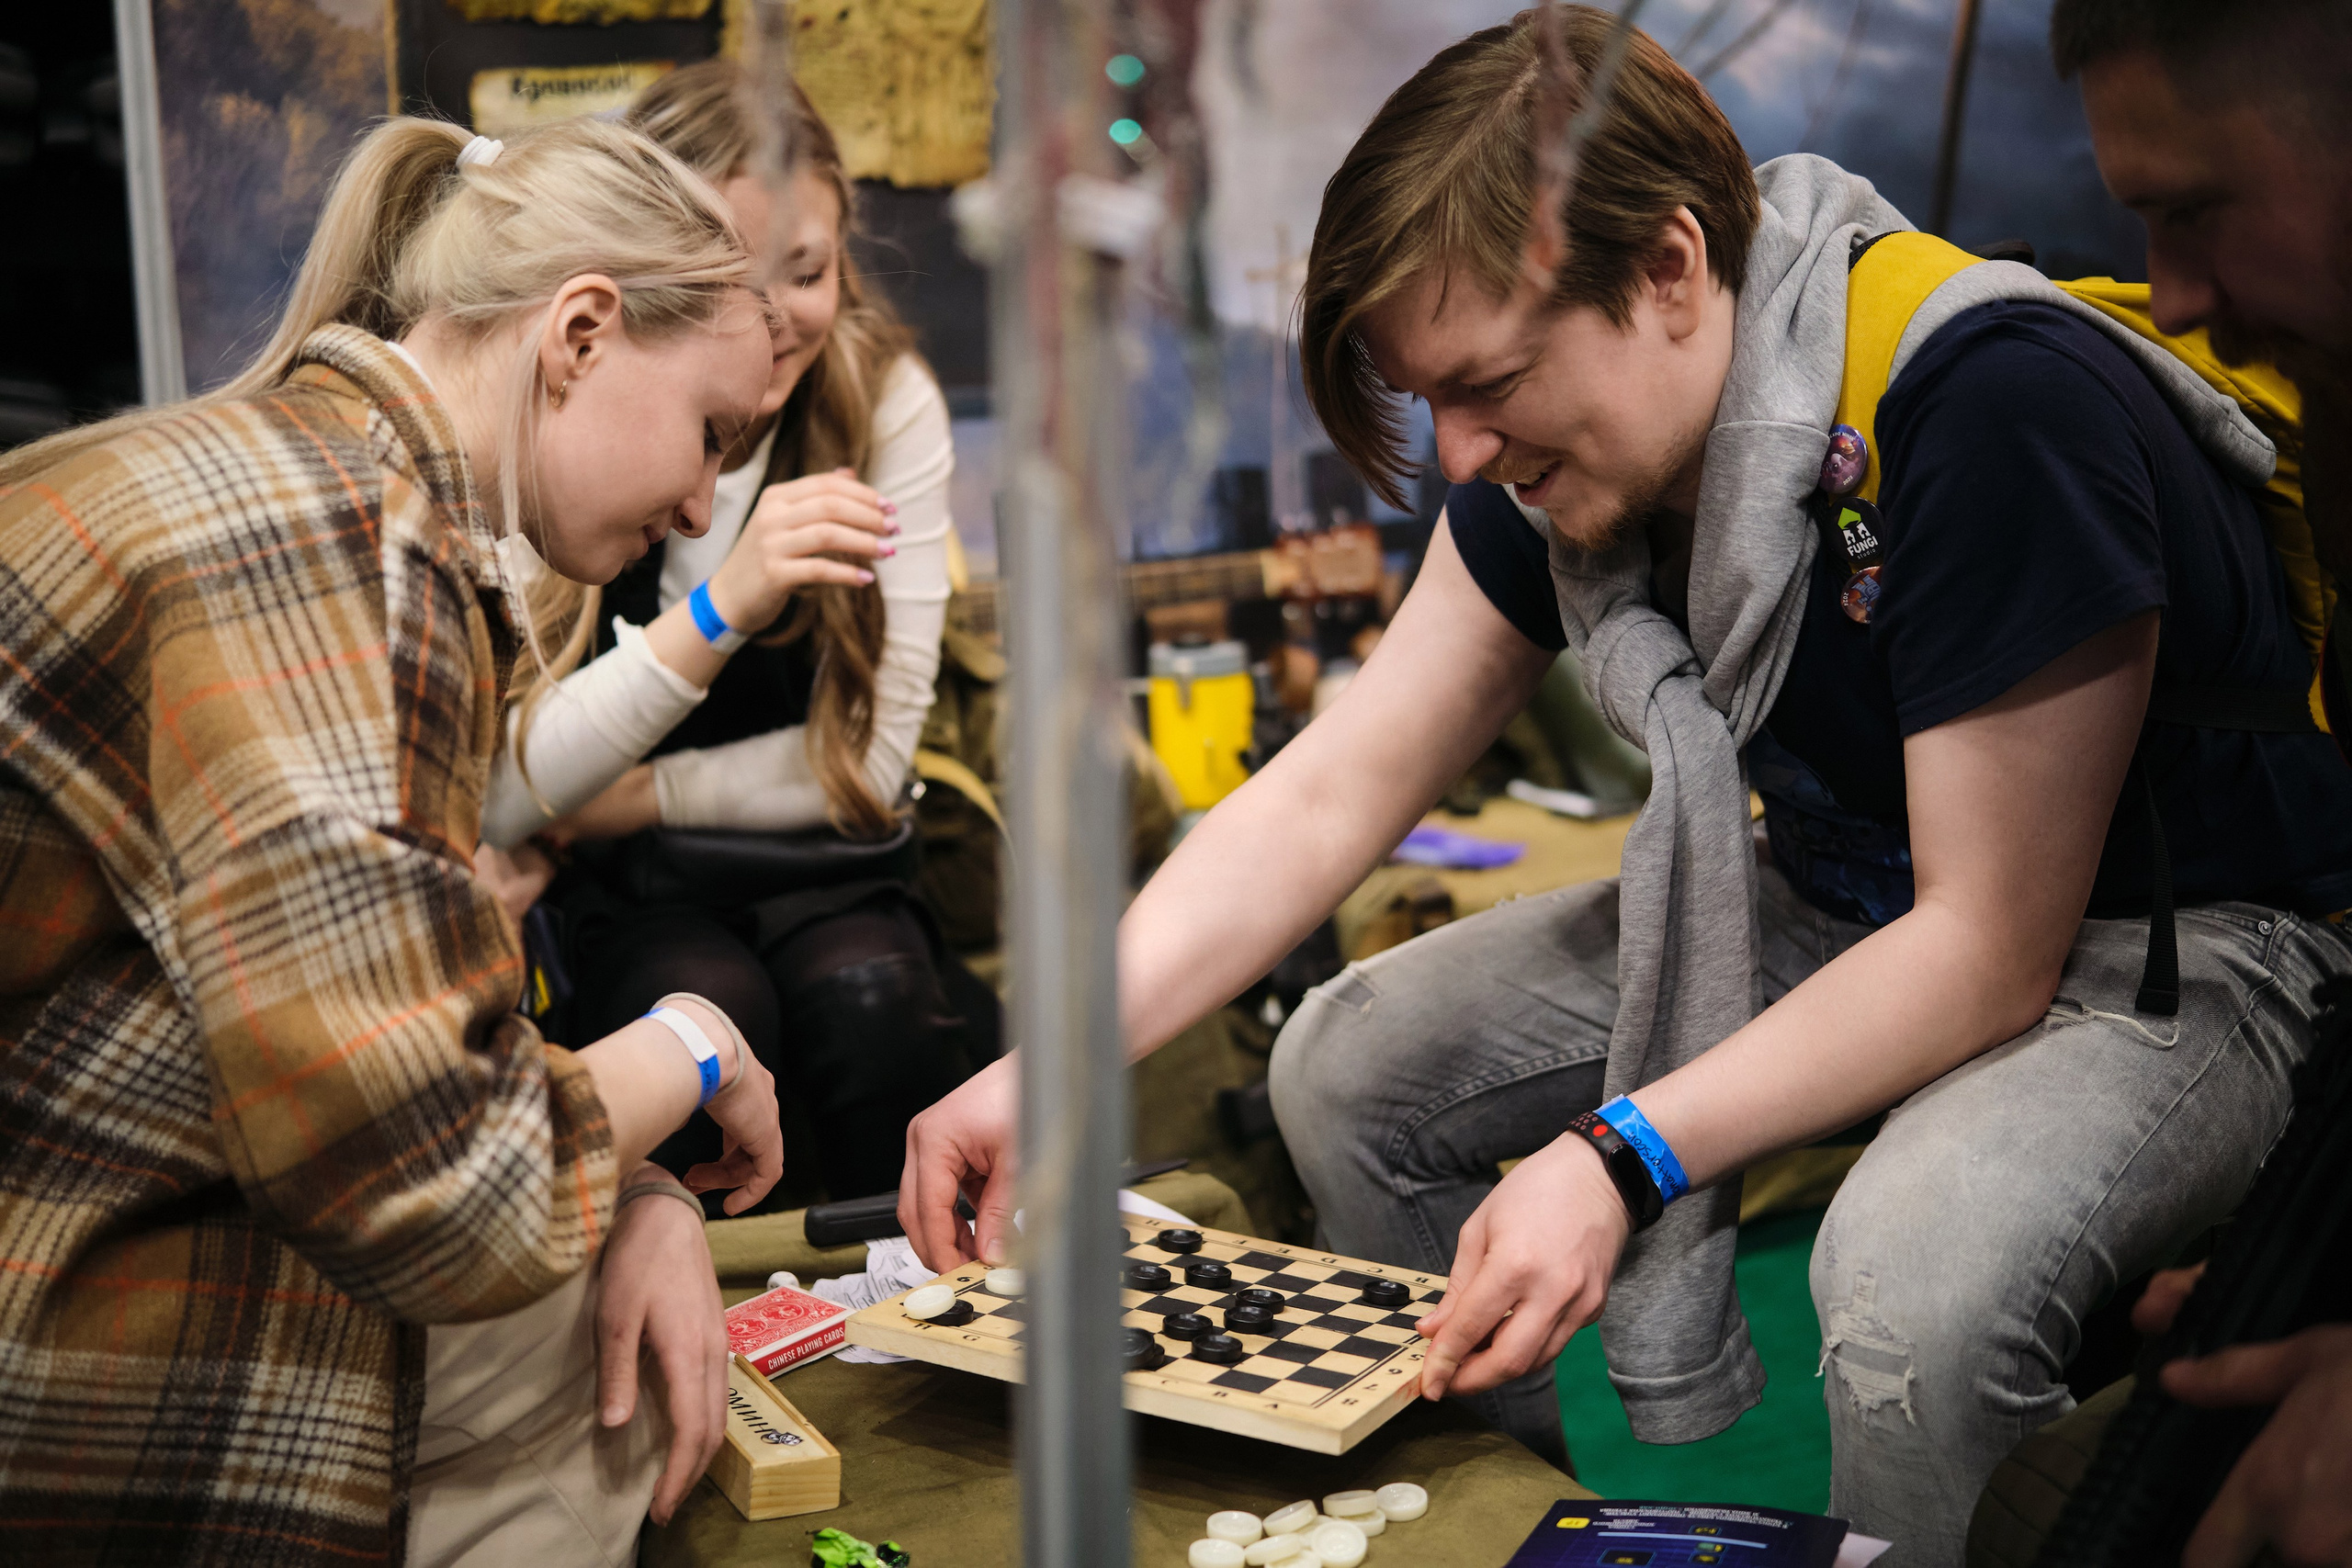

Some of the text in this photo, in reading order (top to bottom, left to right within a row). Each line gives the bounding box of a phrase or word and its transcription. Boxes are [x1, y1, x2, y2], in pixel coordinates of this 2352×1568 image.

[1847, 536, 1878, 557] FUNGI
[1857, 548, 1876, 559] studio
[767, 1326, 845, 1371] CHINESE PLAYING CARDS
